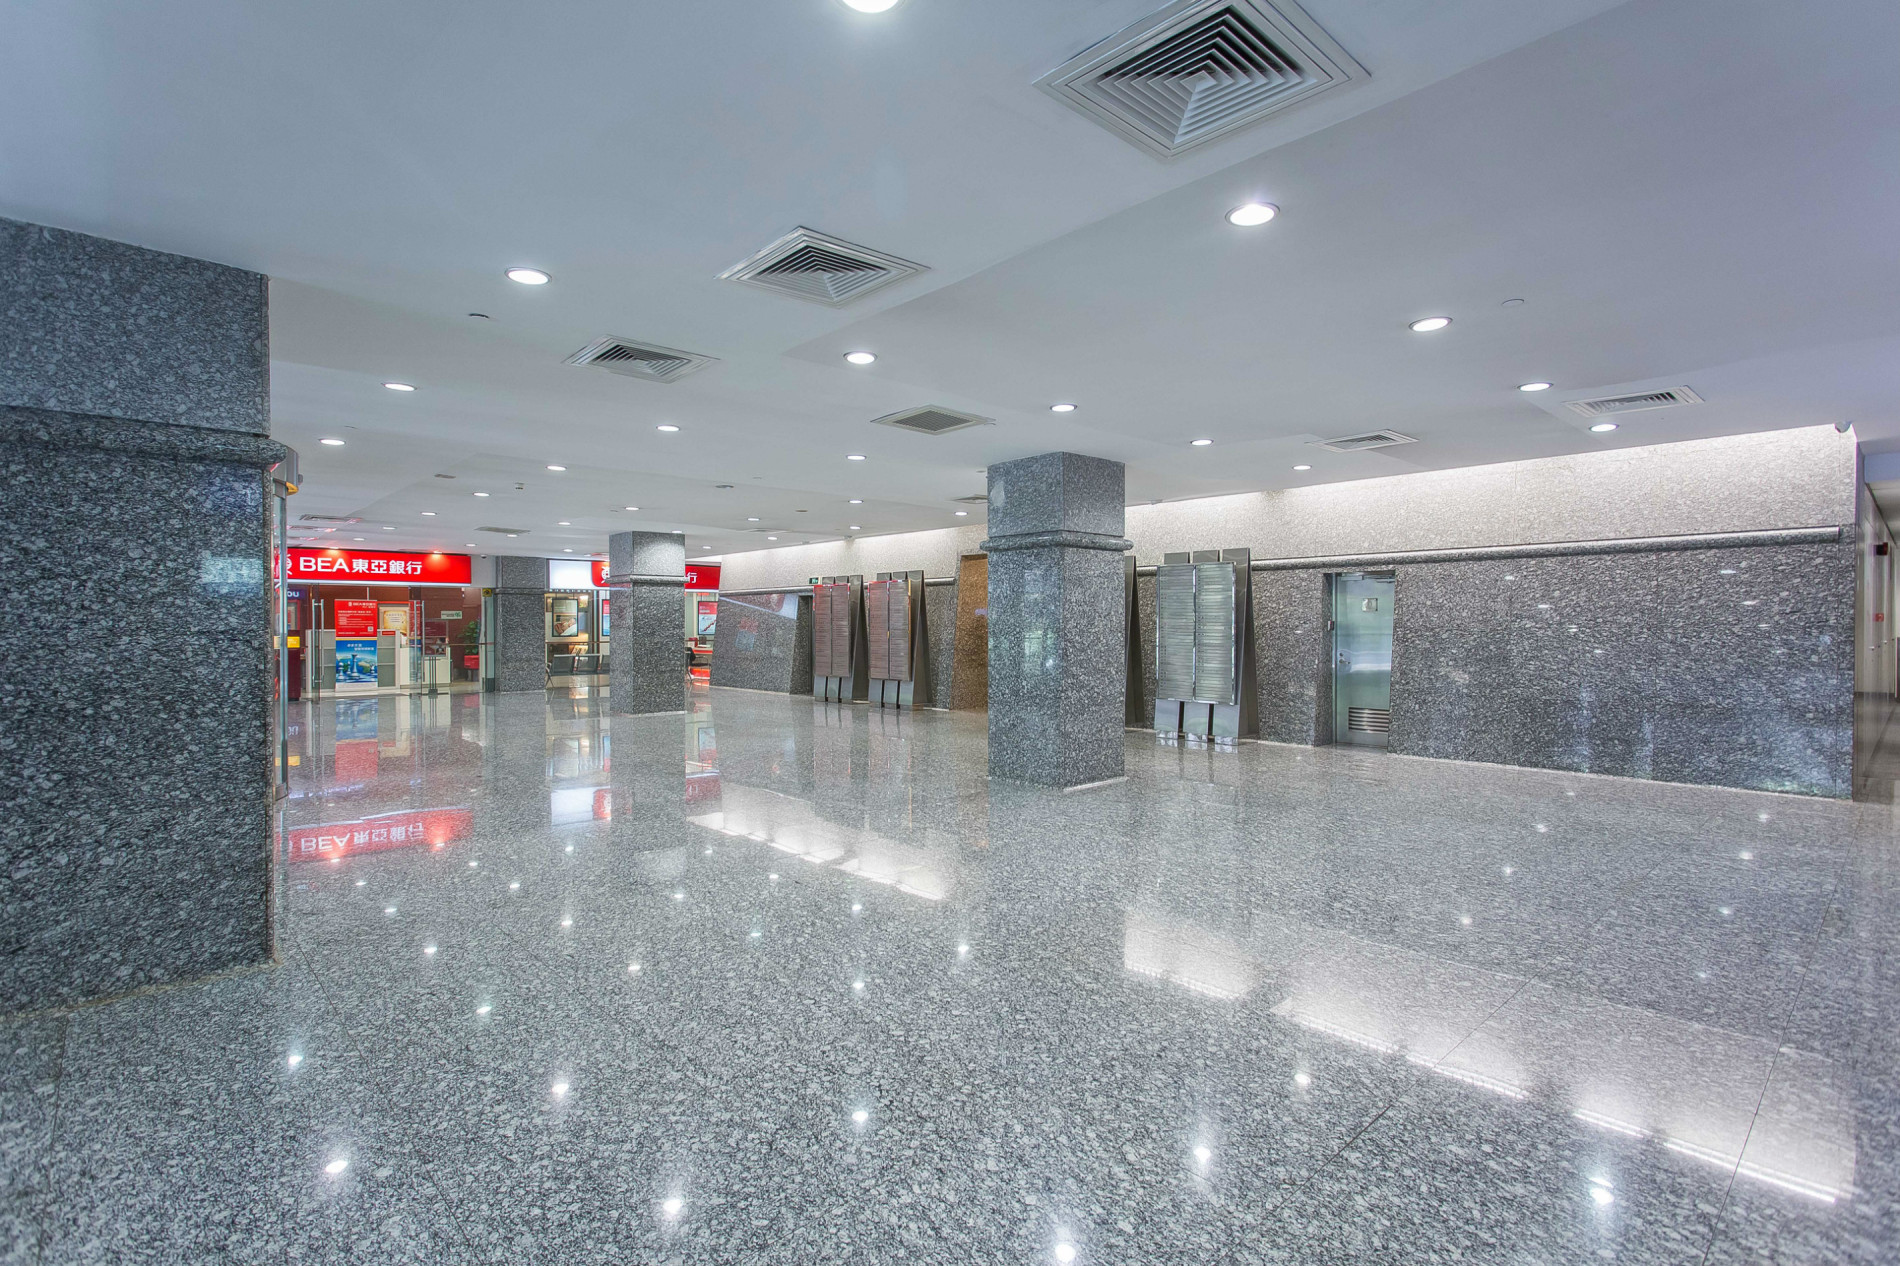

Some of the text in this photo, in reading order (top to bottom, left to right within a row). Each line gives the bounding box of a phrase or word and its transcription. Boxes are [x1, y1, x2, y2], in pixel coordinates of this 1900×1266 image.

[299, 556, 422, 575] BEA 東亞銀行
